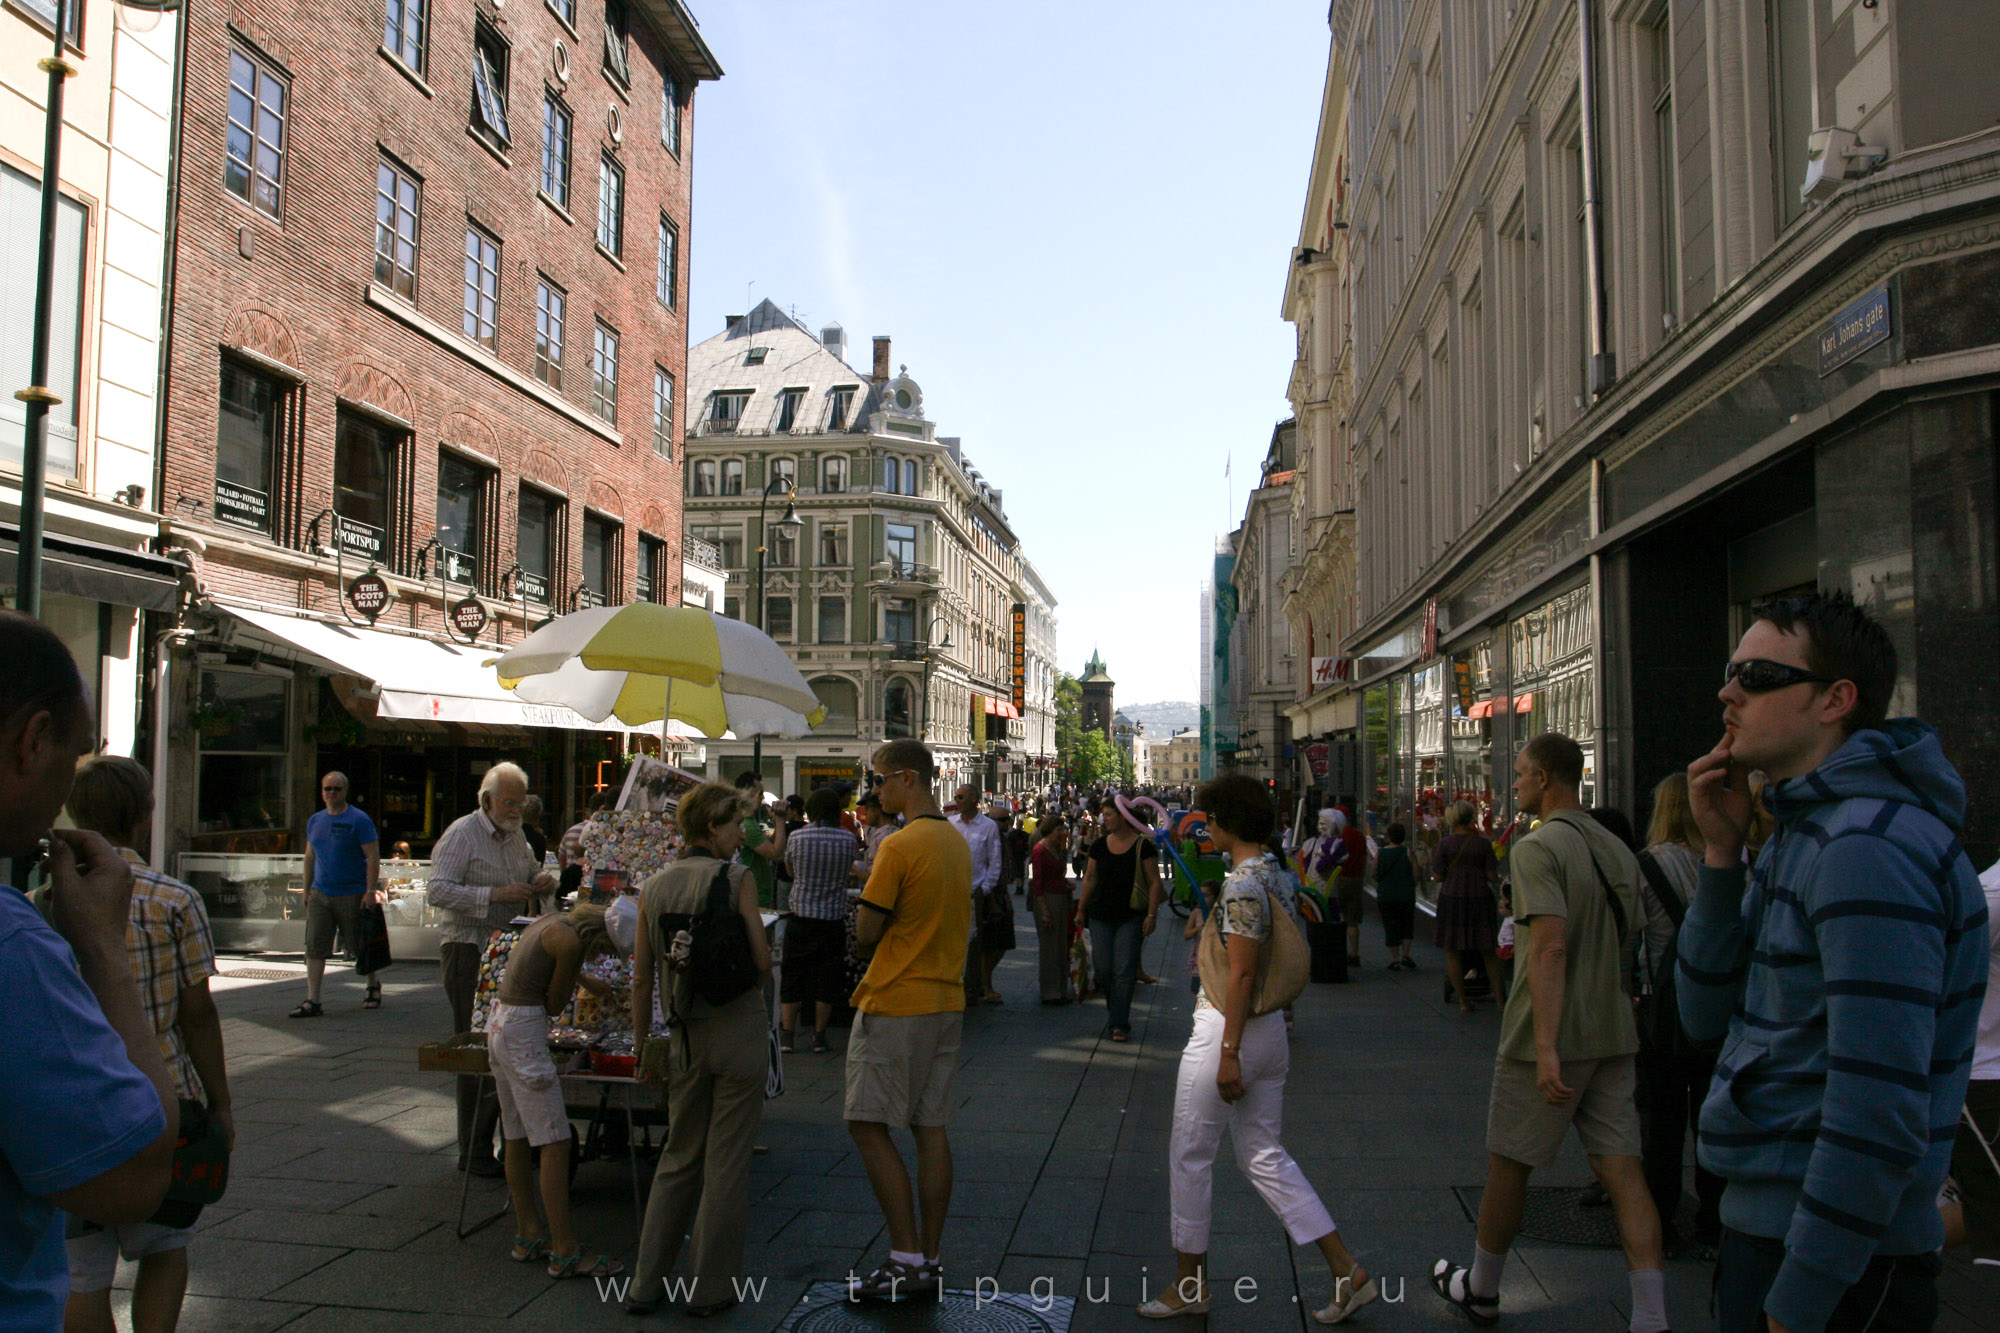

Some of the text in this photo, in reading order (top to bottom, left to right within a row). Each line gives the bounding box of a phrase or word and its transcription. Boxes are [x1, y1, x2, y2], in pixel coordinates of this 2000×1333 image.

[1821, 331, 1837, 357] Karl
[1839, 317, 1864, 346] Johans
[1866, 303, 1883, 333] gate
[217, 486, 265, 507] BILJARD FOTBALL
[215, 495, 266, 516] STORSKJERM DART
[334, 528, 380, 551] SPORTSPUB
[359, 583, 379, 592] THE
[354, 591, 384, 600] SCOTS
[358, 599, 380, 608] MAN
[461, 606, 479, 614] THE
[456, 613, 483, 622] SCOTS
[460, 620, 480, 628] MAN
[1014, 612, 1025, 708] DRESSMANN
[1316, 658, 1350, 682] H&M
[521, 705, 576, 727] STEAKHOUSE
[800, 768, 854, 776] DRESSMANN
